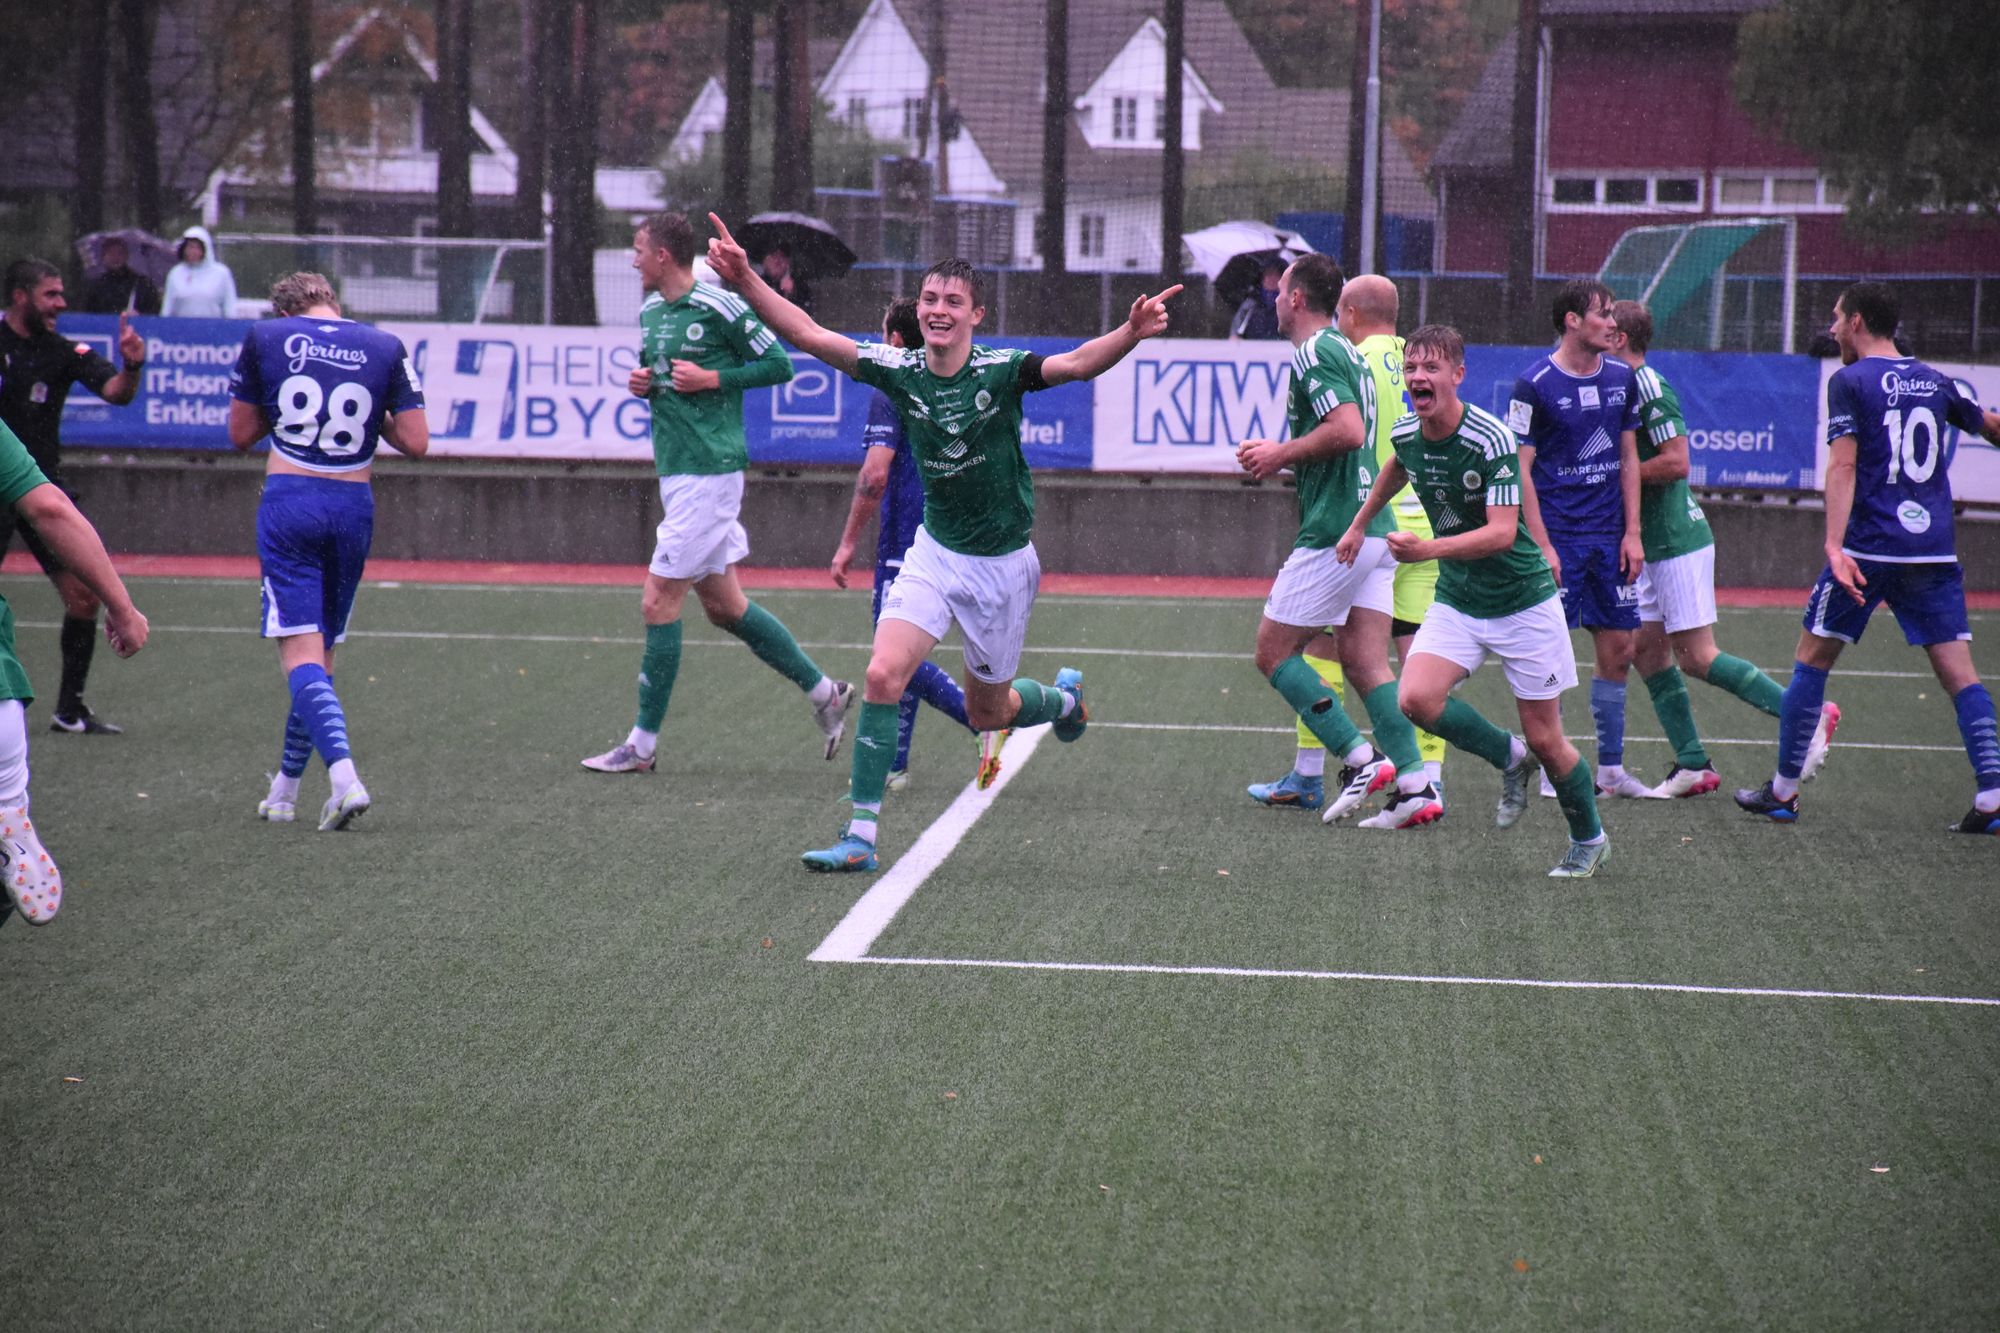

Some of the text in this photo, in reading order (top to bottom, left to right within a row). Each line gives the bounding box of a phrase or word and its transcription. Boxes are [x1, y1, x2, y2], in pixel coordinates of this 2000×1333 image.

[284, 333, 367, 373] Gorines
[526, 345, 638, 387] HEIS
[146, 398, 230, 426] Enkler
[273, 375, 373, 456] 88
[526, 397, 654, 440] BYG
[1133, 360, 1293, 445] KIW
[1687, 423, 1774, 451] osseri
[1883, 406, 1939, 484] 10
[1586, 475, 1607, 484] SØR
